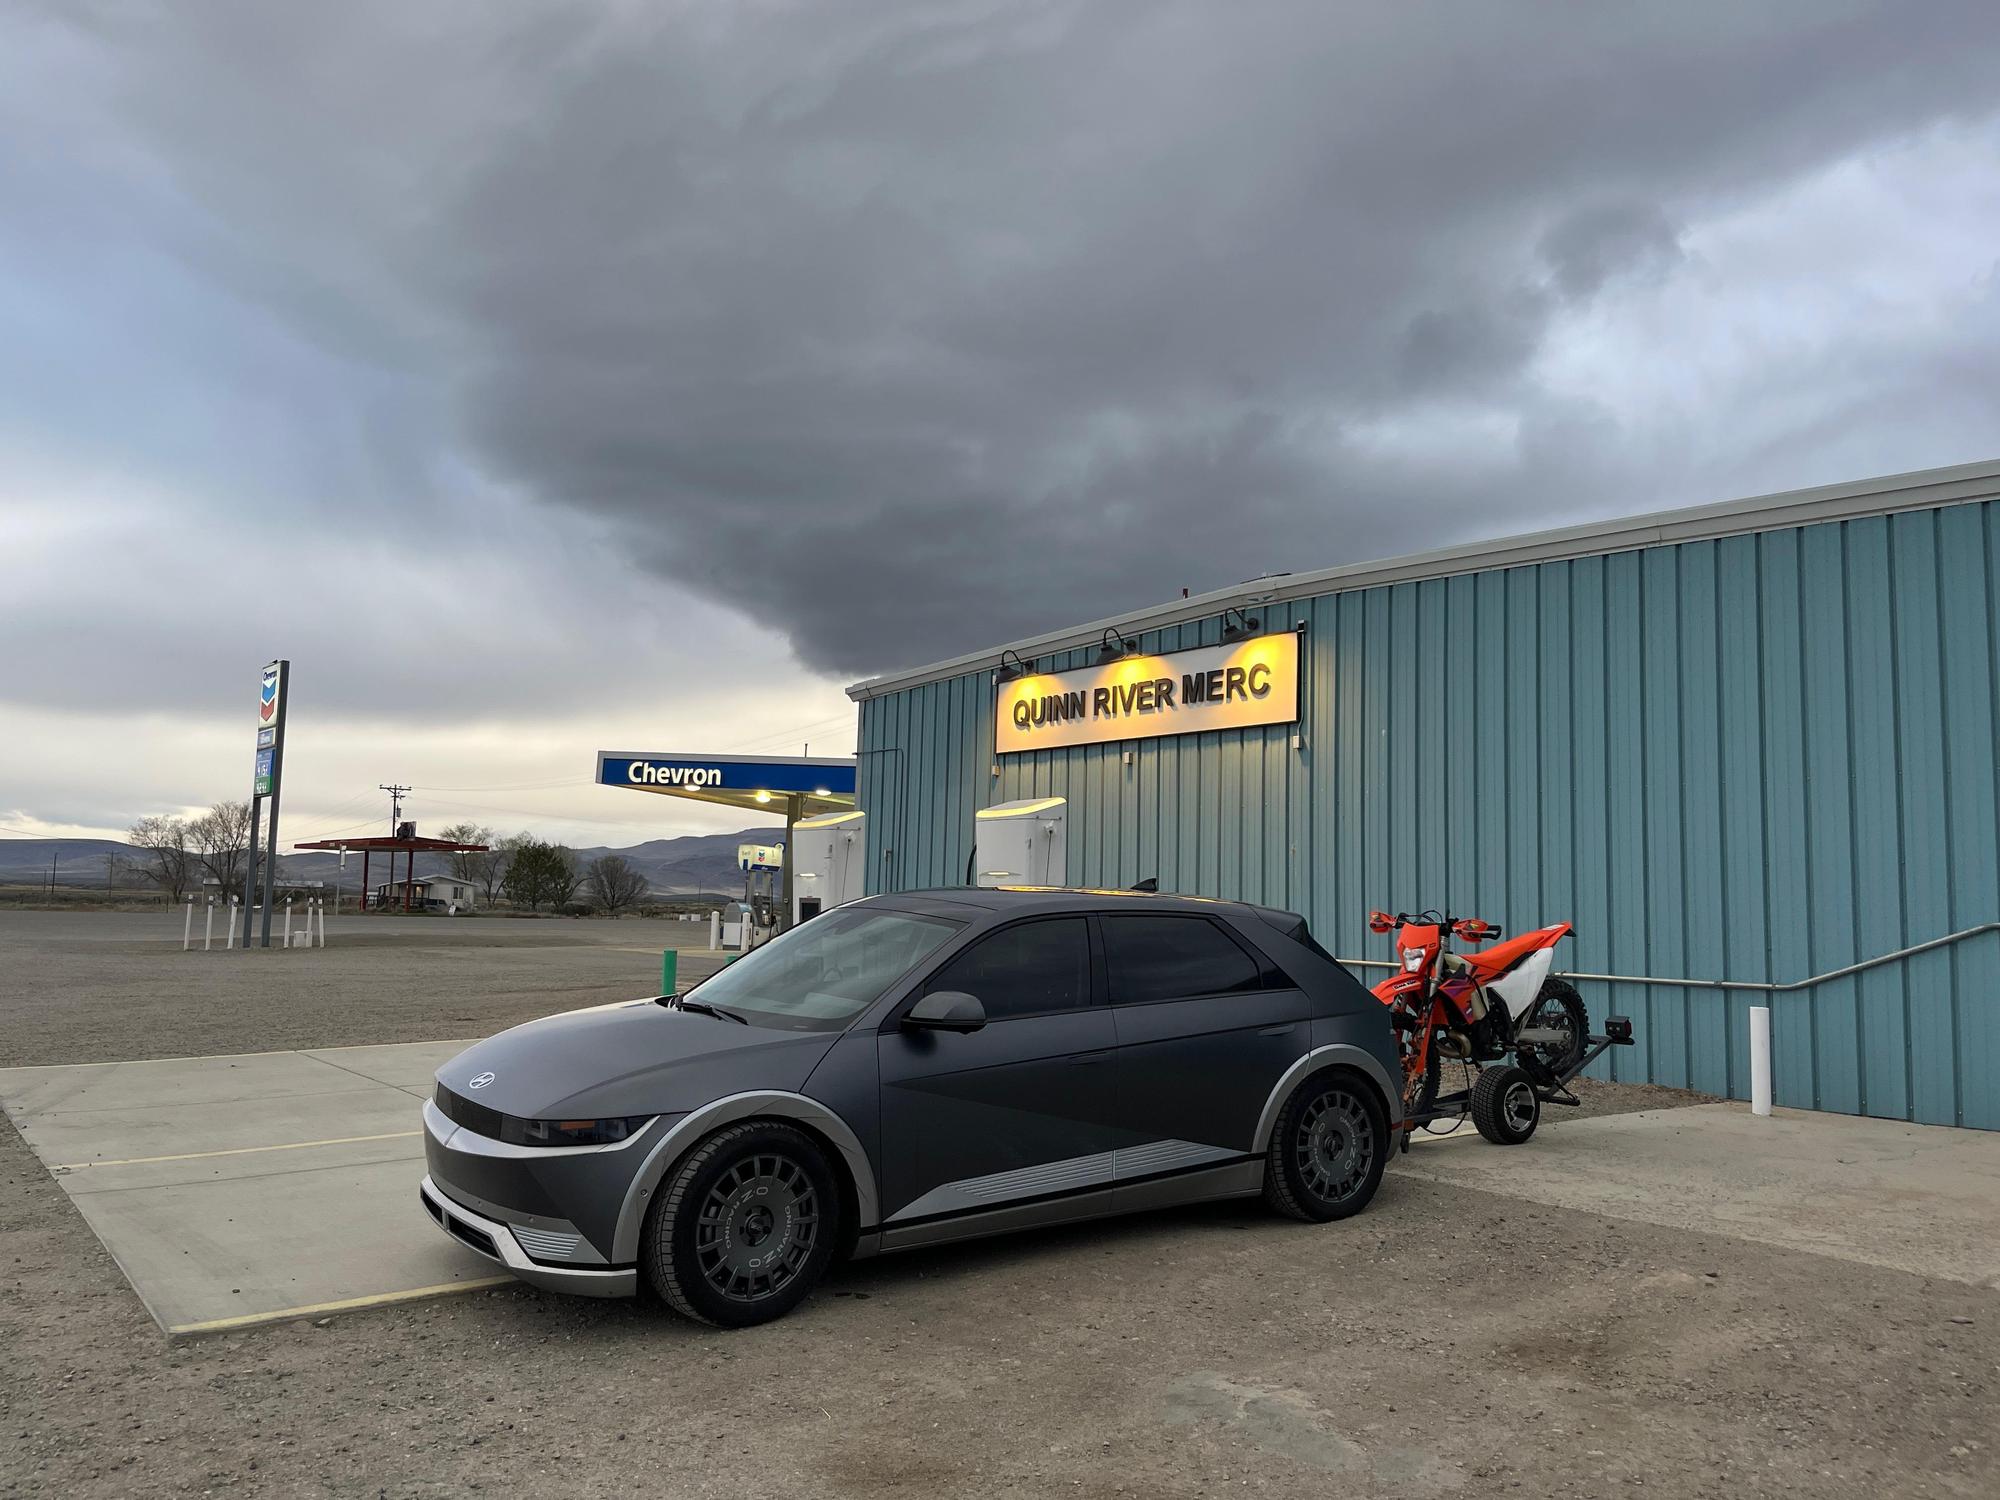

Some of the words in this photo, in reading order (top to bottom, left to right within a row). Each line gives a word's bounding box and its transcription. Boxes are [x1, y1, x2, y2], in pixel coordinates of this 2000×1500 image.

[1013, 690, 1086, 728] QUINN
[1093, 677, 1175, 716] RIVER
[1181, 663, 1272, 704] MERC
[628, 761, 721, 786] Chevron
